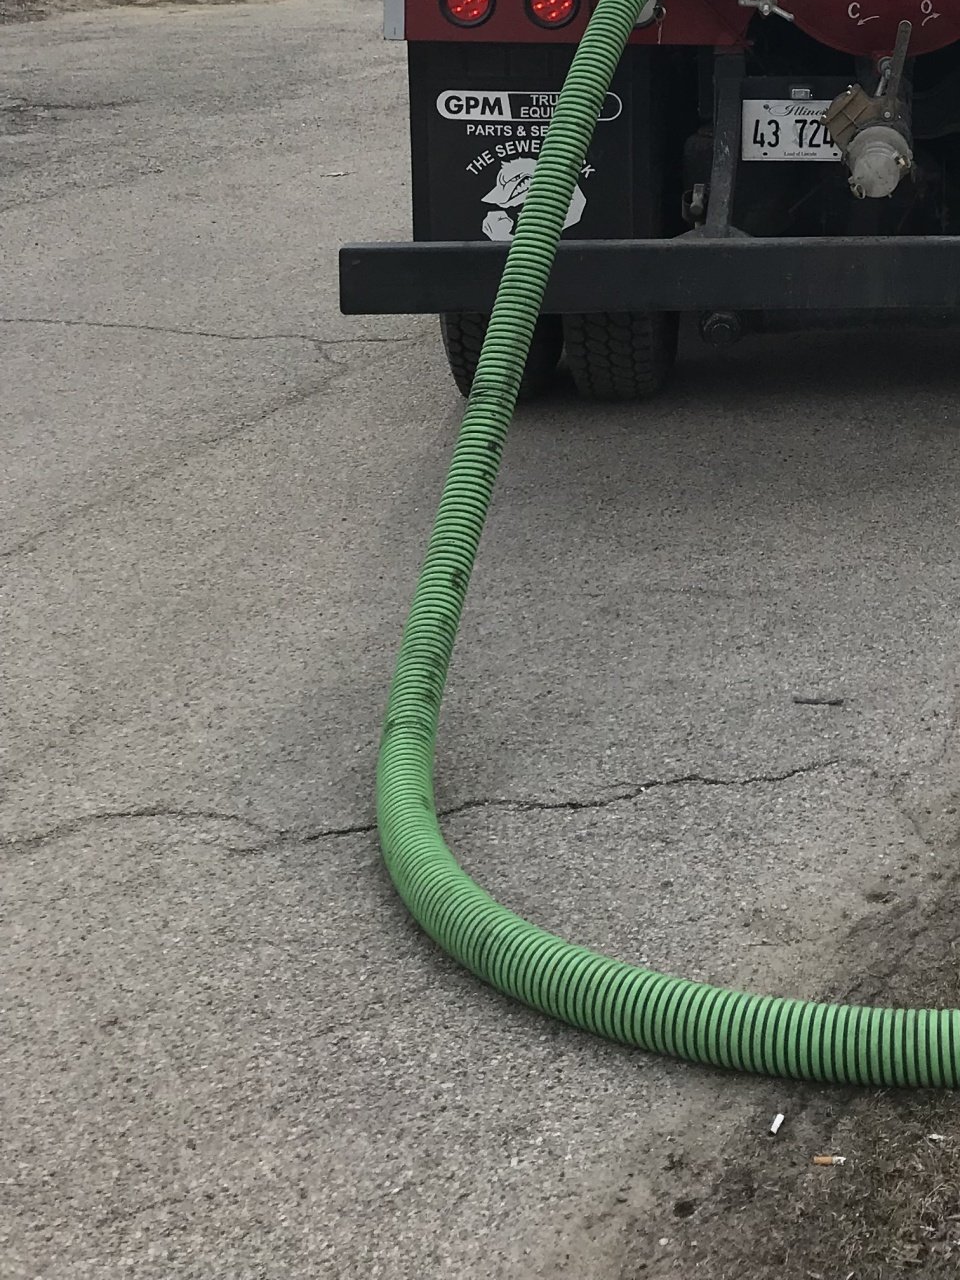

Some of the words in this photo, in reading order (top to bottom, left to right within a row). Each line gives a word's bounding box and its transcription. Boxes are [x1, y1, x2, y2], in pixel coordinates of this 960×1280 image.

[444, 95, 504, 116] GPM
[530, 94, 559, 106] TRU
[466, 124, 513, 137] PARTS
[516, 125, 527, 137] &
[753, 119, 780, 148] 43
[465, 150, 495, 176] THE
[495, 139, 541, 157] SEWE
